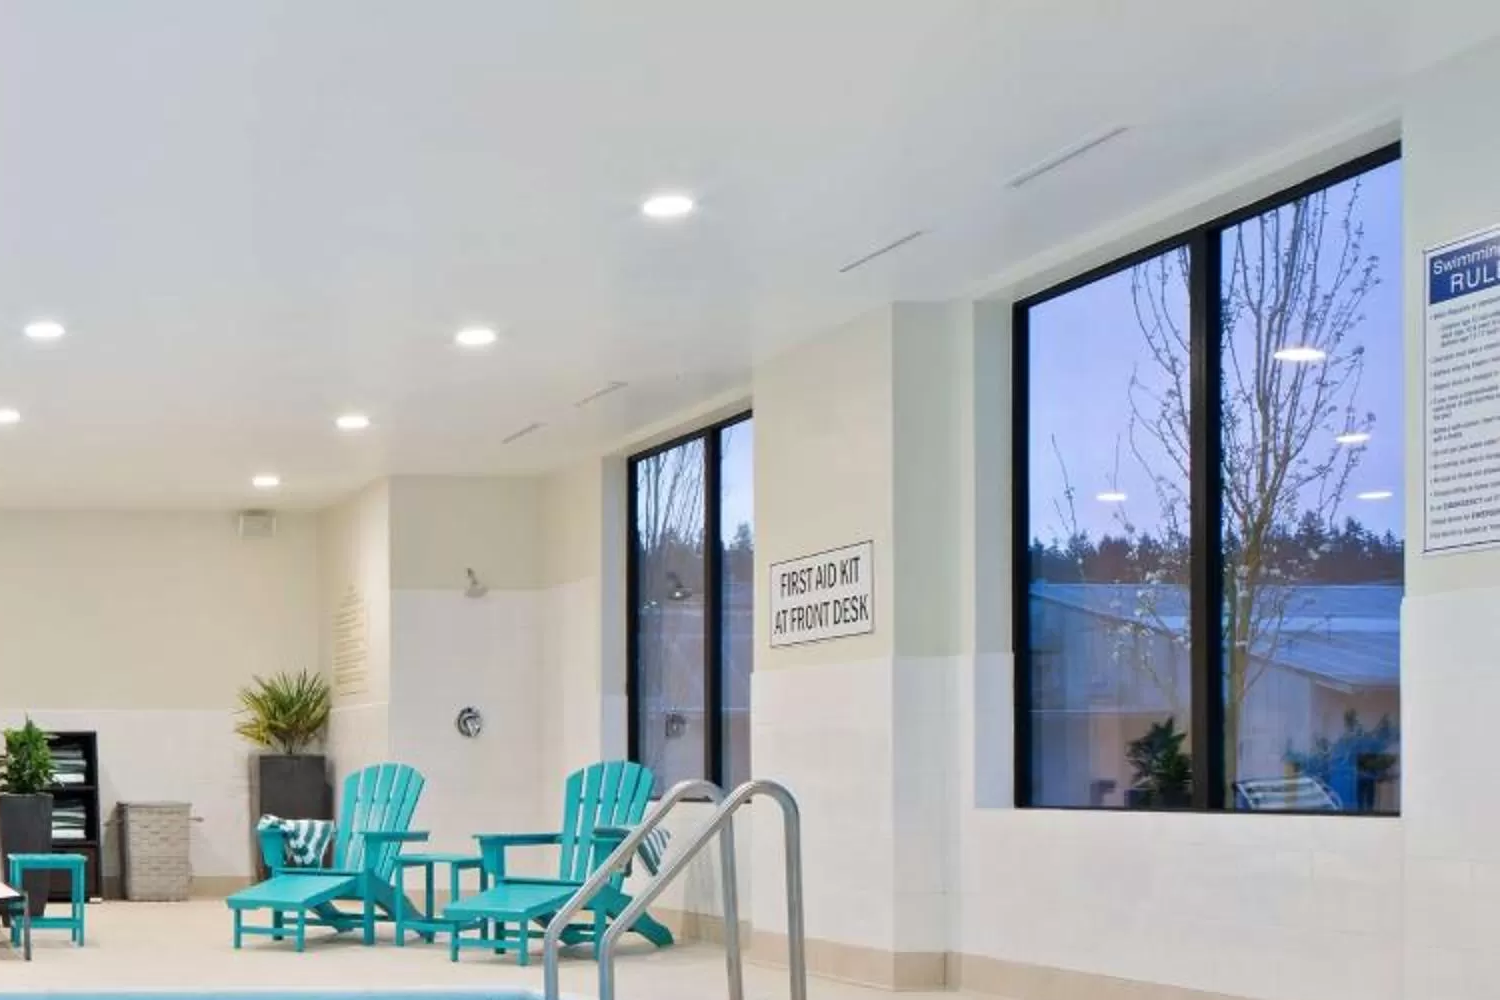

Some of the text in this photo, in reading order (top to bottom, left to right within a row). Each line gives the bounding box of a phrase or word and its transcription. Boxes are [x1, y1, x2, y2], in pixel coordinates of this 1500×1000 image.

[1432, 244, 1500, 275] Swimmin
[780, 555, 861, 599] FIRST AID KIT
[774, 593, 869, 634] AT FRONT DESK
